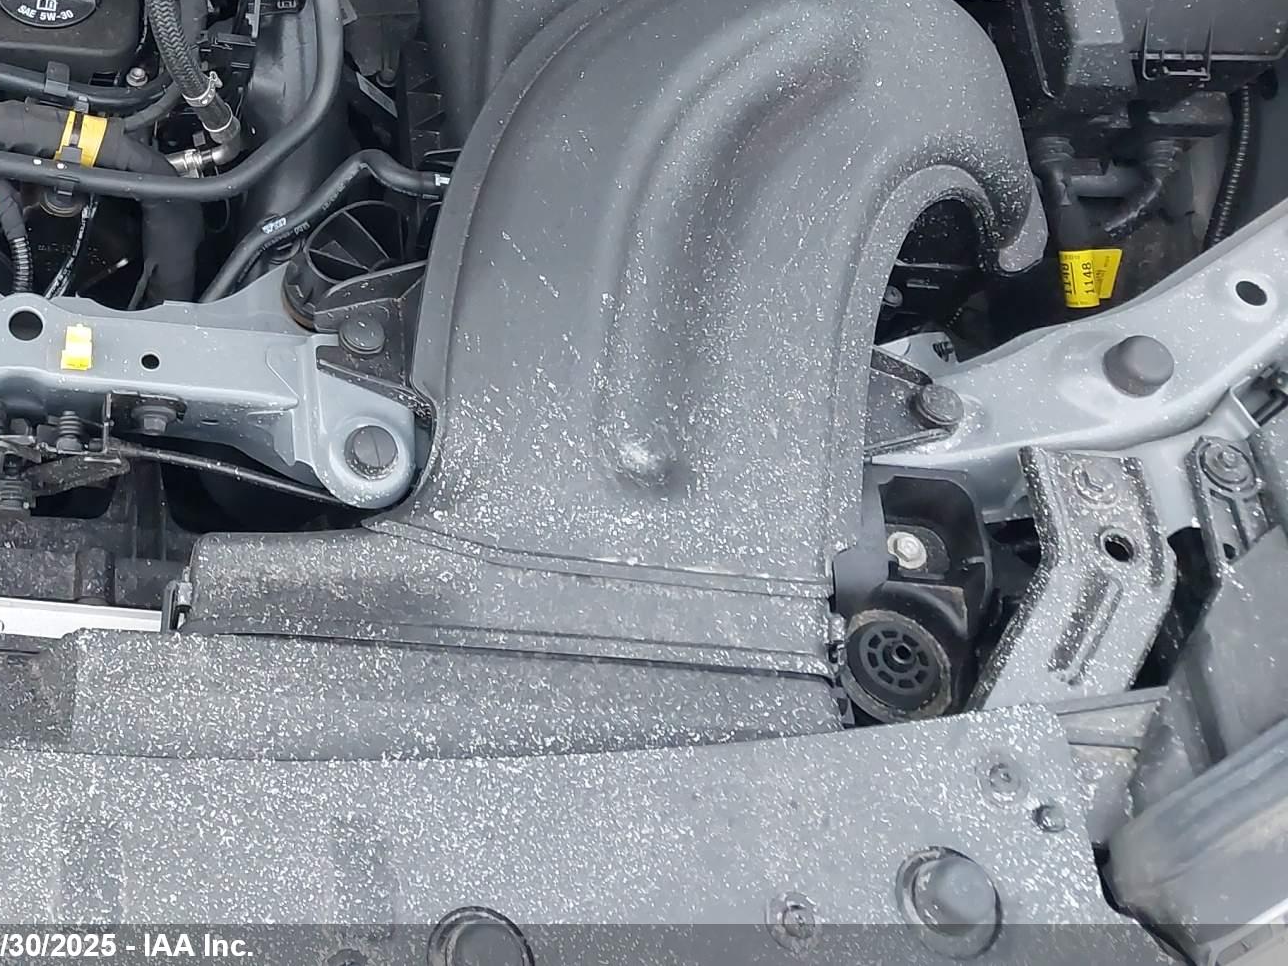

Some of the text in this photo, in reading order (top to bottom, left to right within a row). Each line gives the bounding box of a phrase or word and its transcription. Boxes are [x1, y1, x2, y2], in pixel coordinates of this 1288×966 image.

[17, 4, 74, 21] SAE 5W-30
[1081, 261, 1095, 294] 1148
